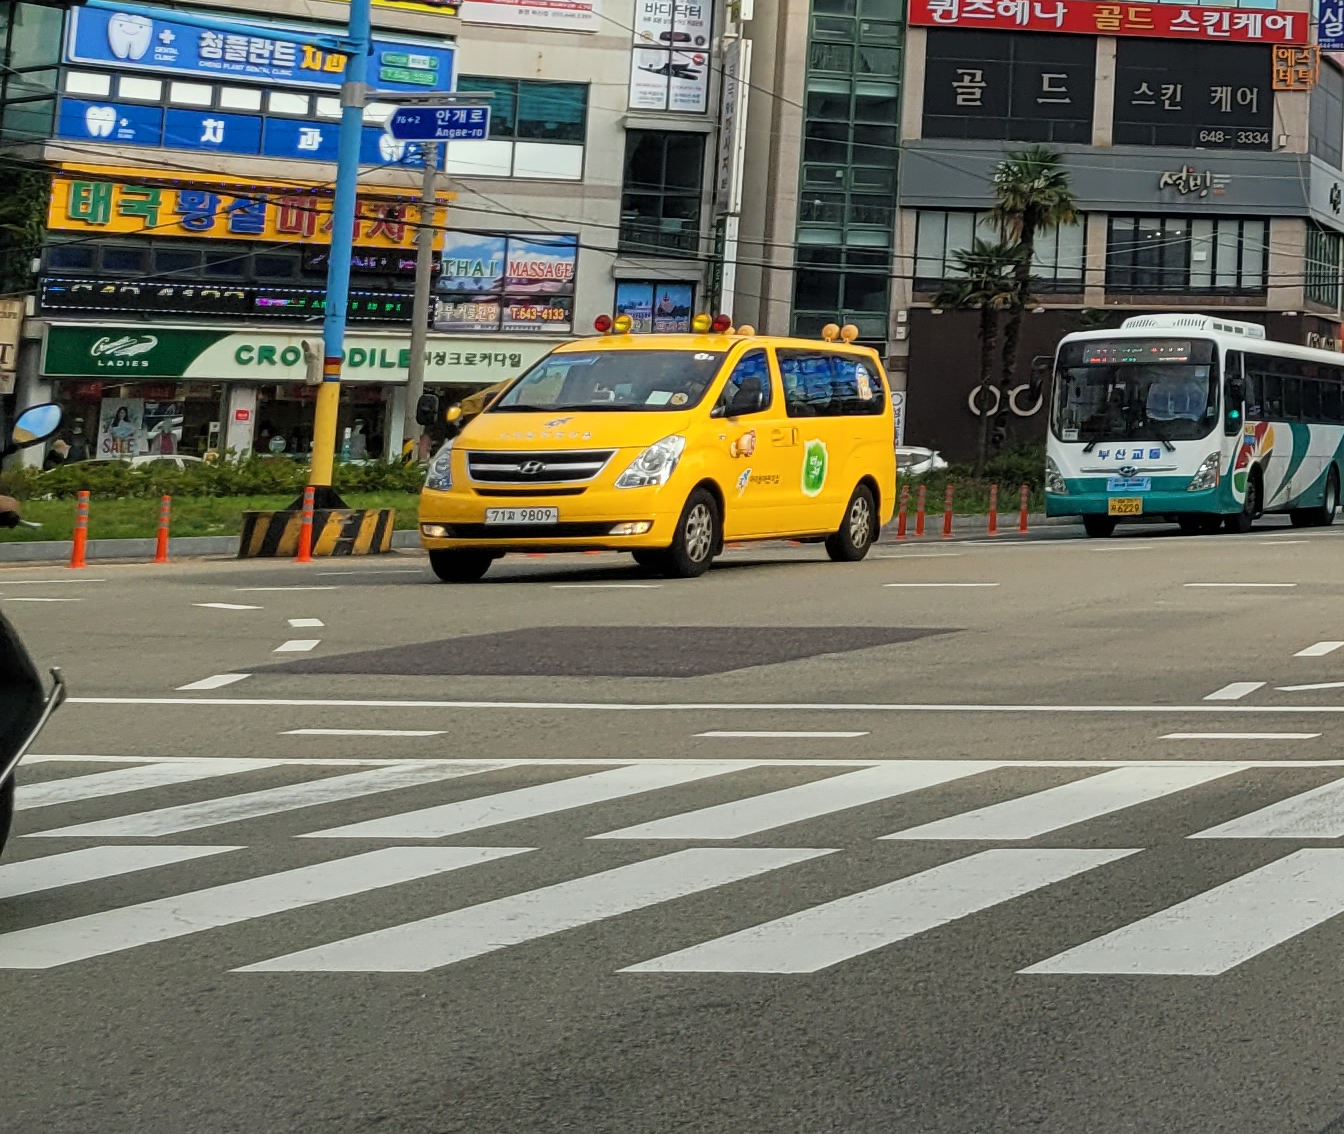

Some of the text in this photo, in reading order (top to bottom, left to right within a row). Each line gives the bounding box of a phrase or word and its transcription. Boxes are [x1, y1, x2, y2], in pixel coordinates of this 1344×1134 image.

[1094, 5, 1154, 30] 골드
[1169, 10, 1294, 40] 스킨케어
[436, 109, 484, 126] 안개로
[436, 127, 483, 140] Angae-ro
[69, 180, 268, 234] 태국 황실
[443, 259, 574, 278] THAI MASSAGE
[102, 438, 134, 453] SALE
[520, 509, 552, 523] 9809
